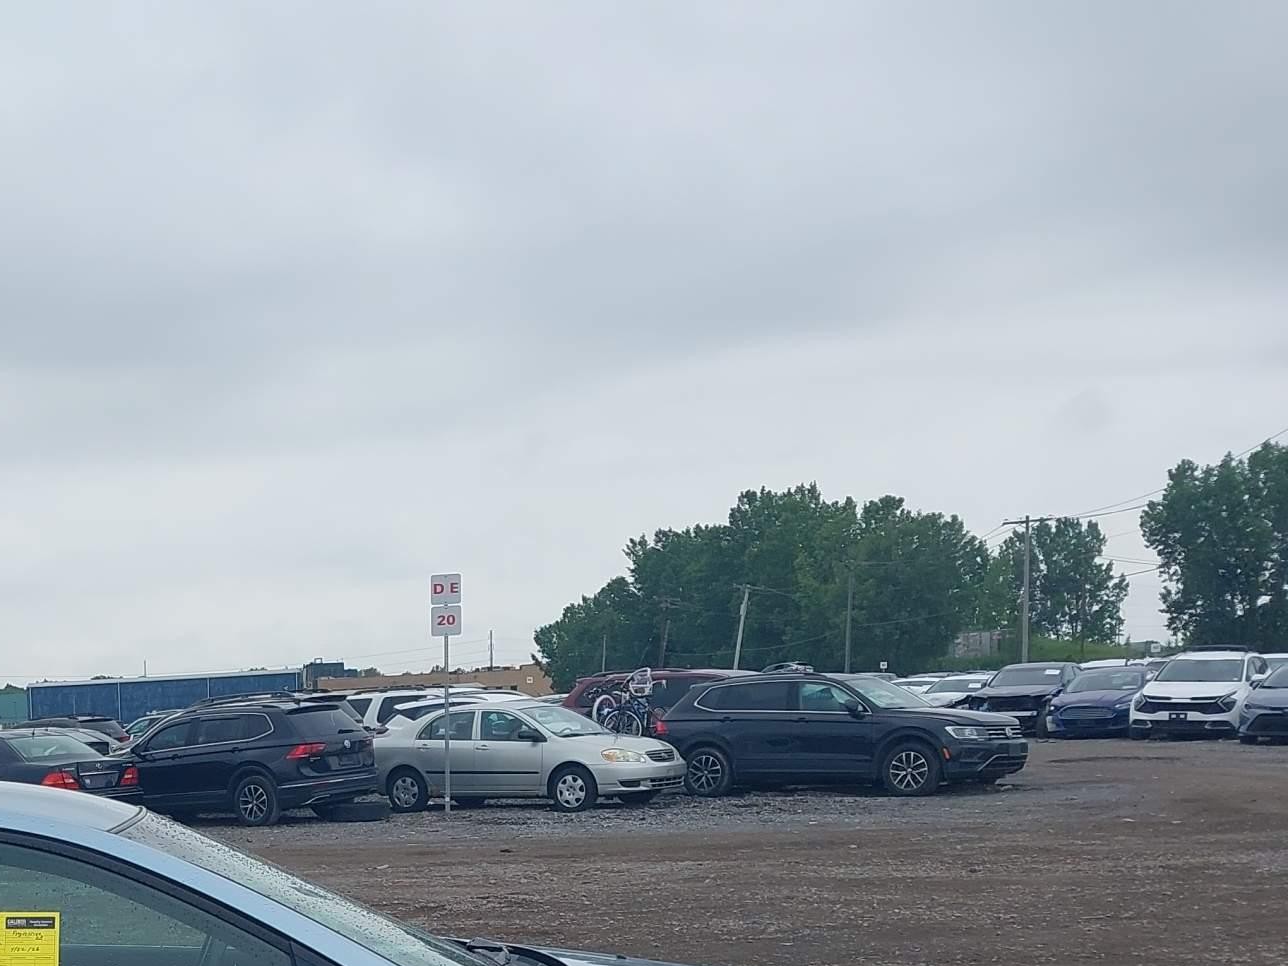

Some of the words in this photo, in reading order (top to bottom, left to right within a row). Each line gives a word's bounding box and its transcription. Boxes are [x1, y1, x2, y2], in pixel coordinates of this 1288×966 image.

[433, 583, 445, 595] D
[450, 582, 460, 594] E
[437, 614, 456, 626] 20
